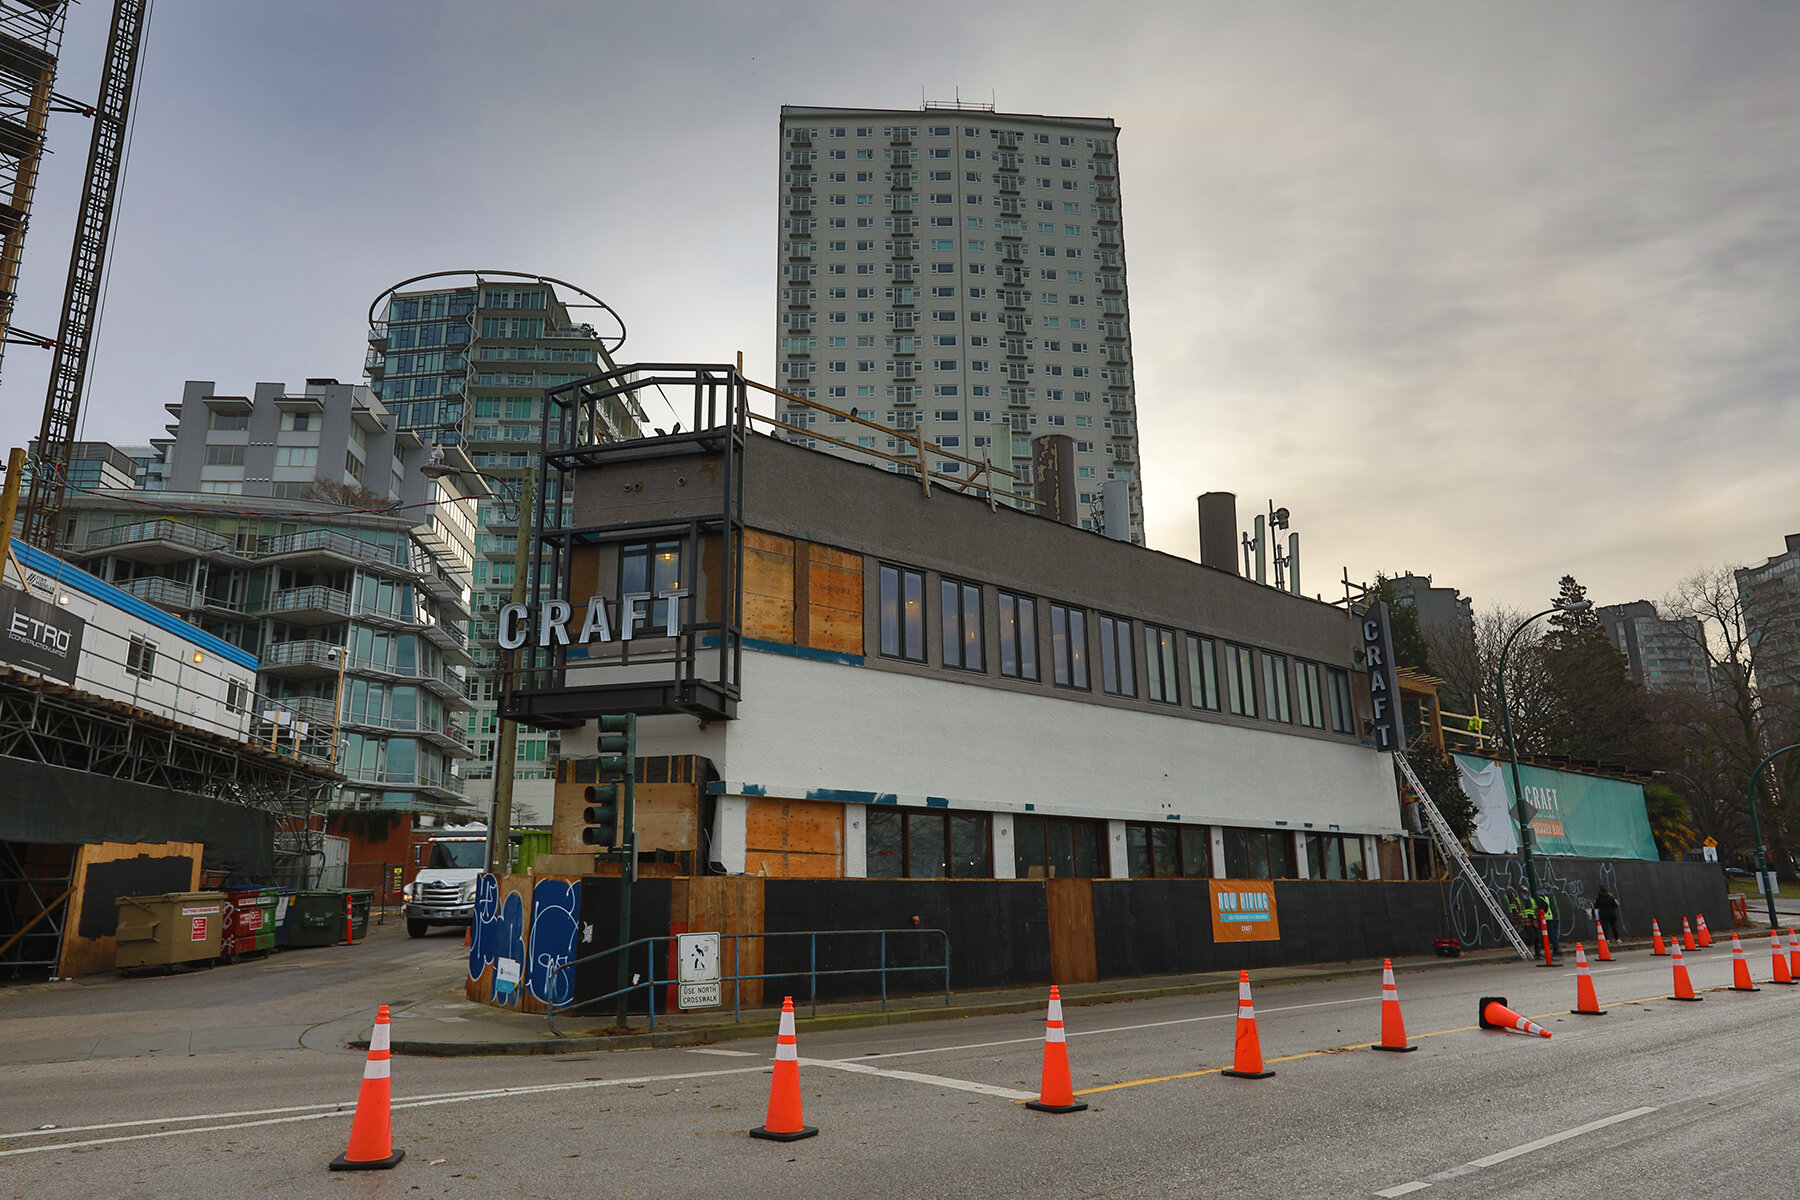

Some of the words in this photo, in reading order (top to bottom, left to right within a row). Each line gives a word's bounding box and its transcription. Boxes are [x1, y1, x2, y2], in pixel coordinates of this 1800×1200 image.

[8, 608, 71, 651] ETRO
[498, 588, 689, 650] CRAFT
[1363, 619, 1391, 746] CRAFT
[1524, 785, 1559, 812] CRAFT
[1217, 892, 1238, 912] NOW
[1239, 892, 1270, 912] HIRING
[683, 987, 695, 995] USE
[697, 986, 717, 994] NORTH
[683, 995, 718, 1004] CROSSWALK
